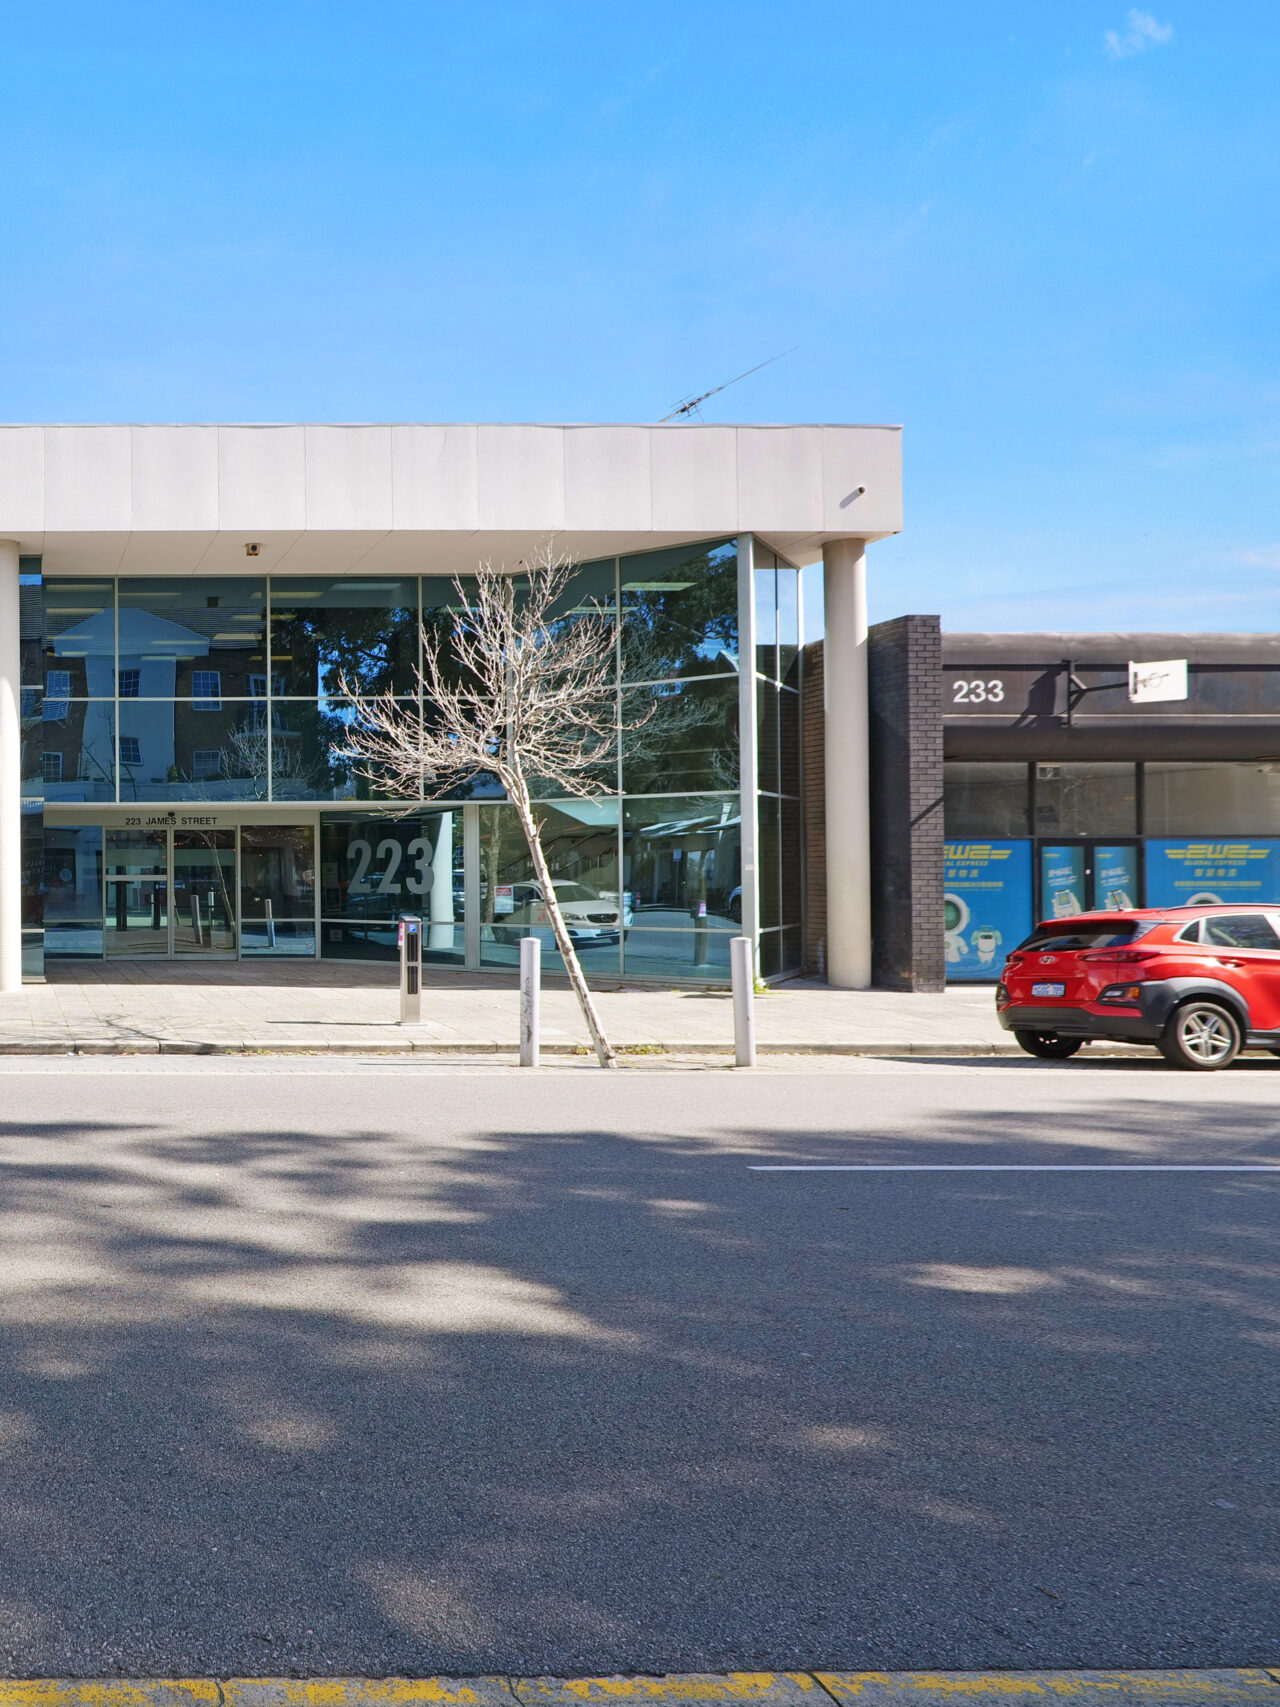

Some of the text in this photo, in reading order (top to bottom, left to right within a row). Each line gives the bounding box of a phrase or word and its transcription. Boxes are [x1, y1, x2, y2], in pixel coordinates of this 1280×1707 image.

[952, 680, 1005, 703] 233
[125, 817, 218, 826] 223 JAMES STREET
[1187, 844, 1251, 858] EWE
[346, 838, 435, 895] 223
